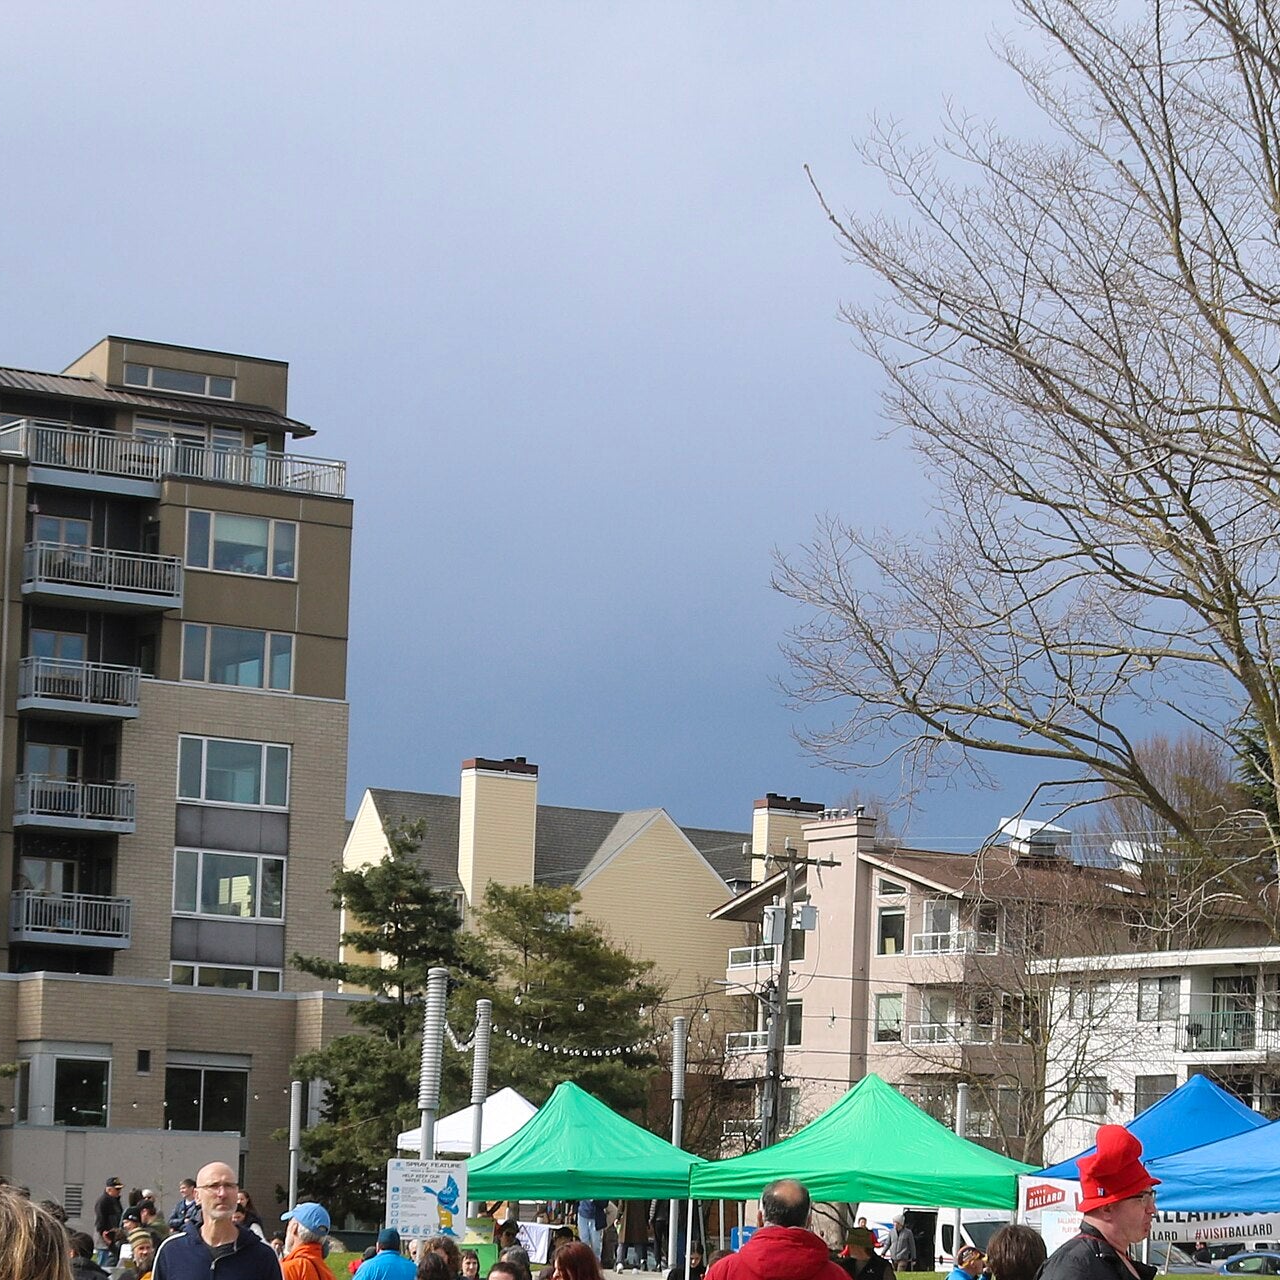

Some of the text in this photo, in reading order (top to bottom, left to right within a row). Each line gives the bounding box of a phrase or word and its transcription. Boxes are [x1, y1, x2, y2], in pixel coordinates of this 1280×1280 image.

[1029, 1192, 1062, 1208] BALLARD
[1153, 1230, 1178, 1242] LARD
[1194, 1222, 1273, 1240] #VISITBALLARD
